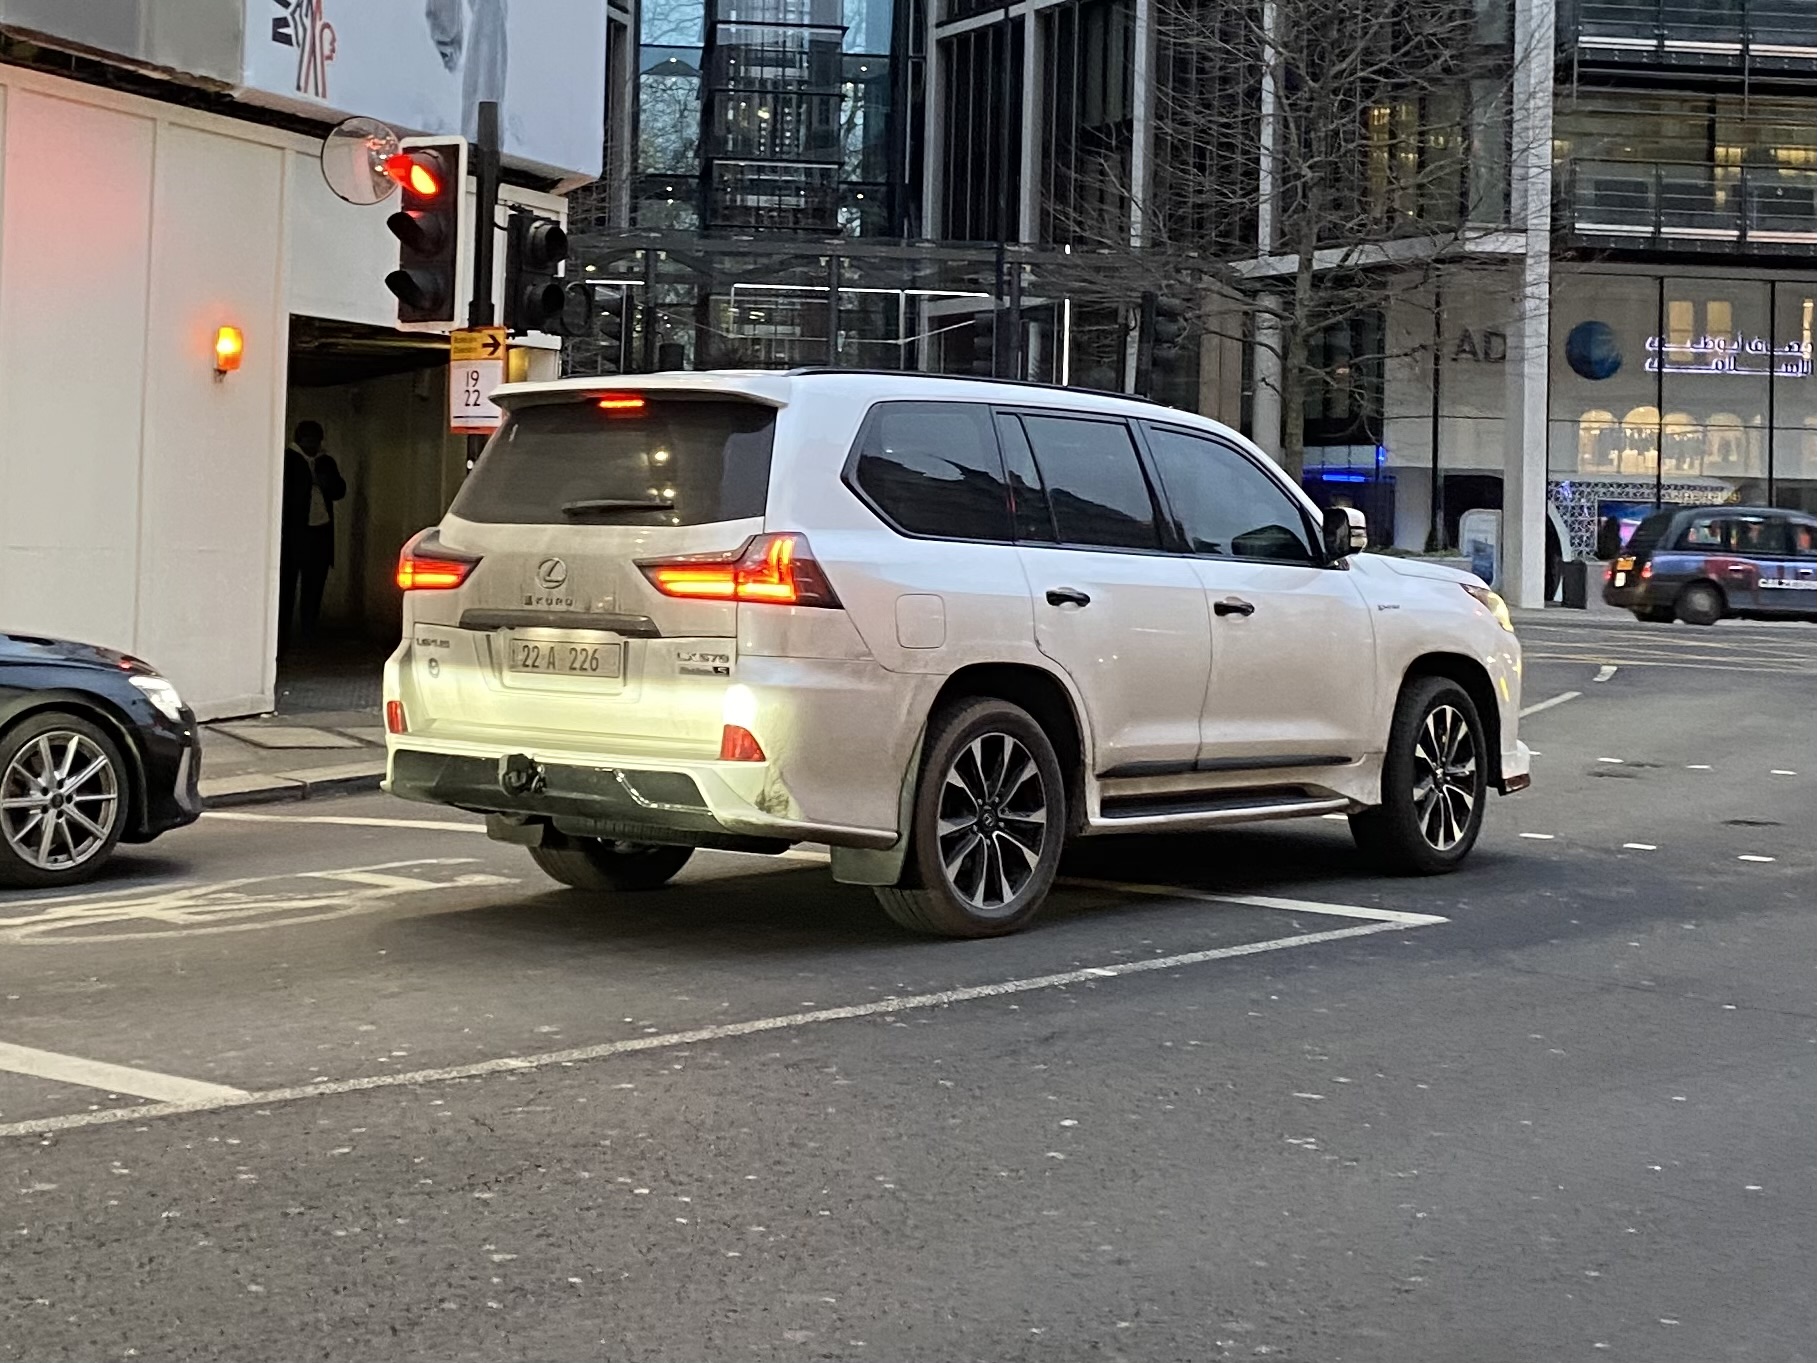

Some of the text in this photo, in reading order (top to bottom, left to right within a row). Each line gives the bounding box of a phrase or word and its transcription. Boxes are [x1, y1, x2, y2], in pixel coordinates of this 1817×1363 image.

[465, 370, 480, 388] 19
[464, 389, 481, 407] 22
[521, 644, 540, 669] 22
[546, 646, 556, 670] A
[568, 646, 600, 672] 226
